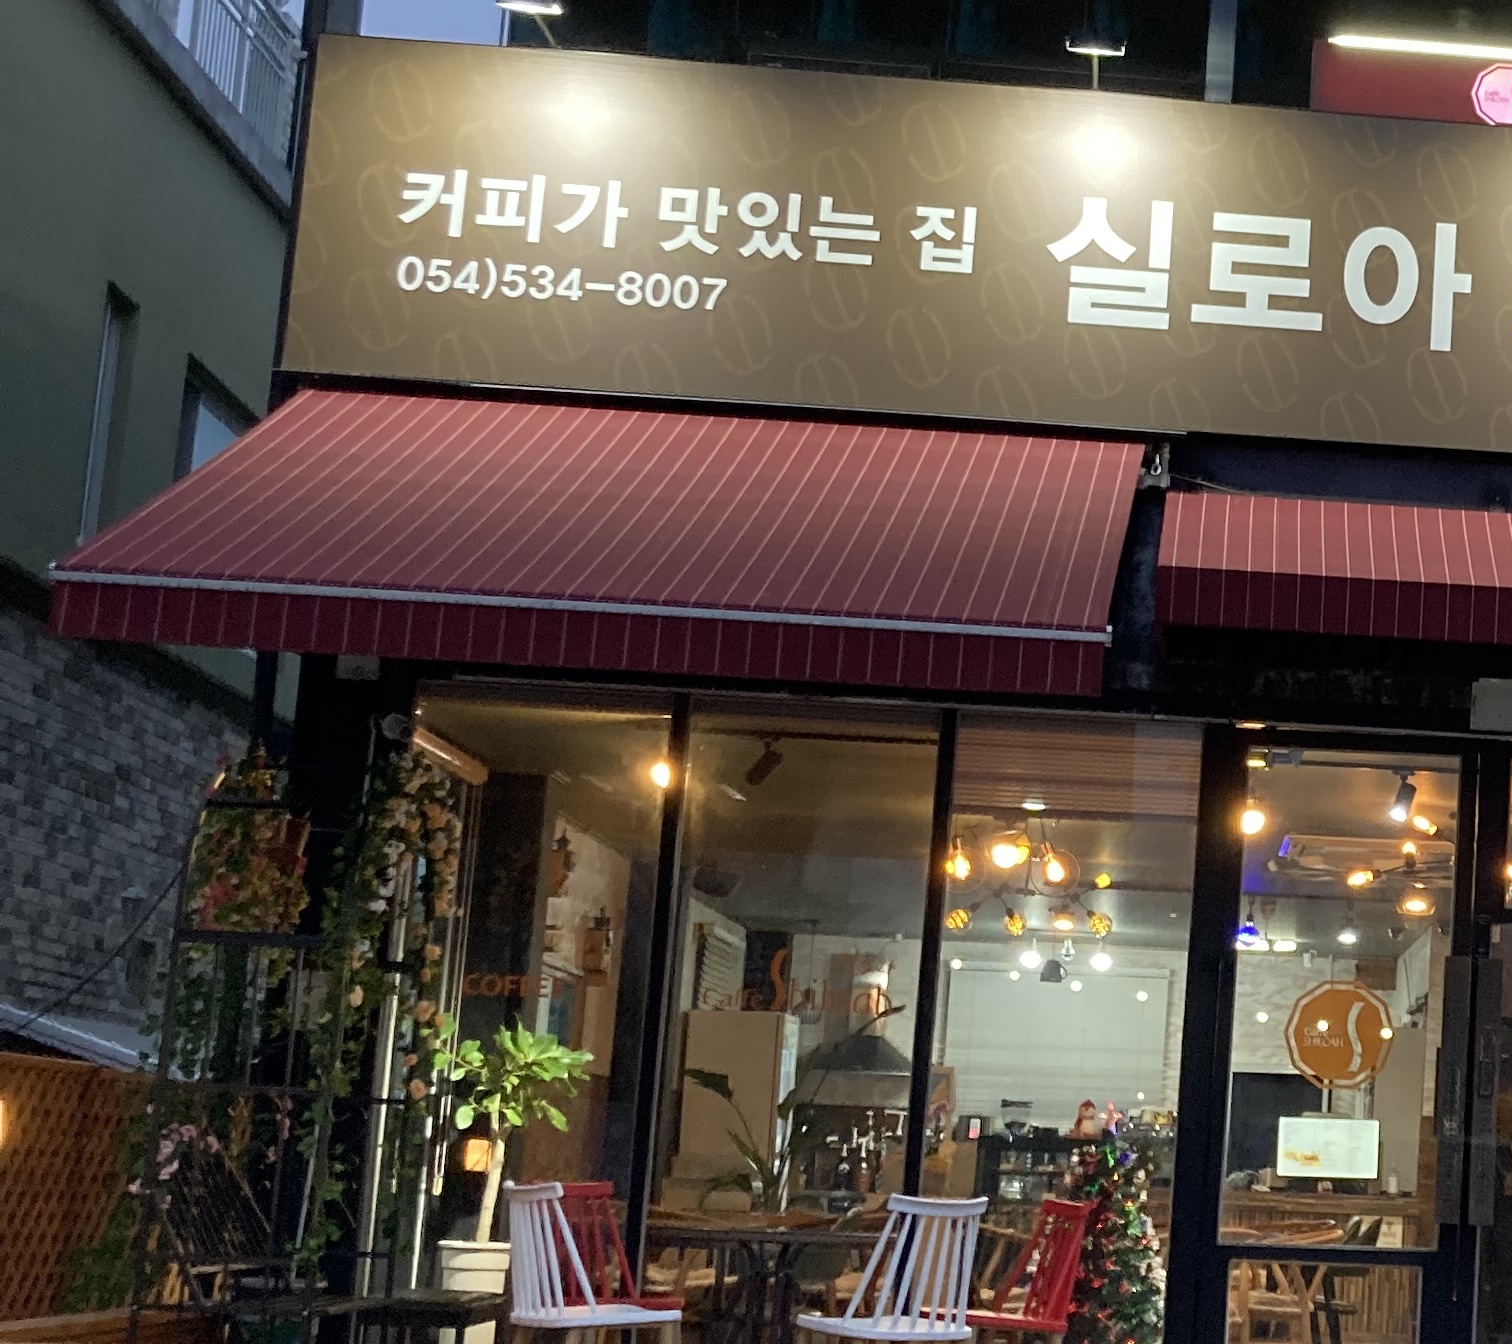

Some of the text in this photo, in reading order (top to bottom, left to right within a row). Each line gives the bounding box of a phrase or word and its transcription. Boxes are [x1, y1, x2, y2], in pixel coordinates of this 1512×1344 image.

[398, 168, 979, 275] 커피가 맛있는 집
[1046, 196, 1472, 352] 실로아
[396, 255, 729, 311] 054)534-8007
